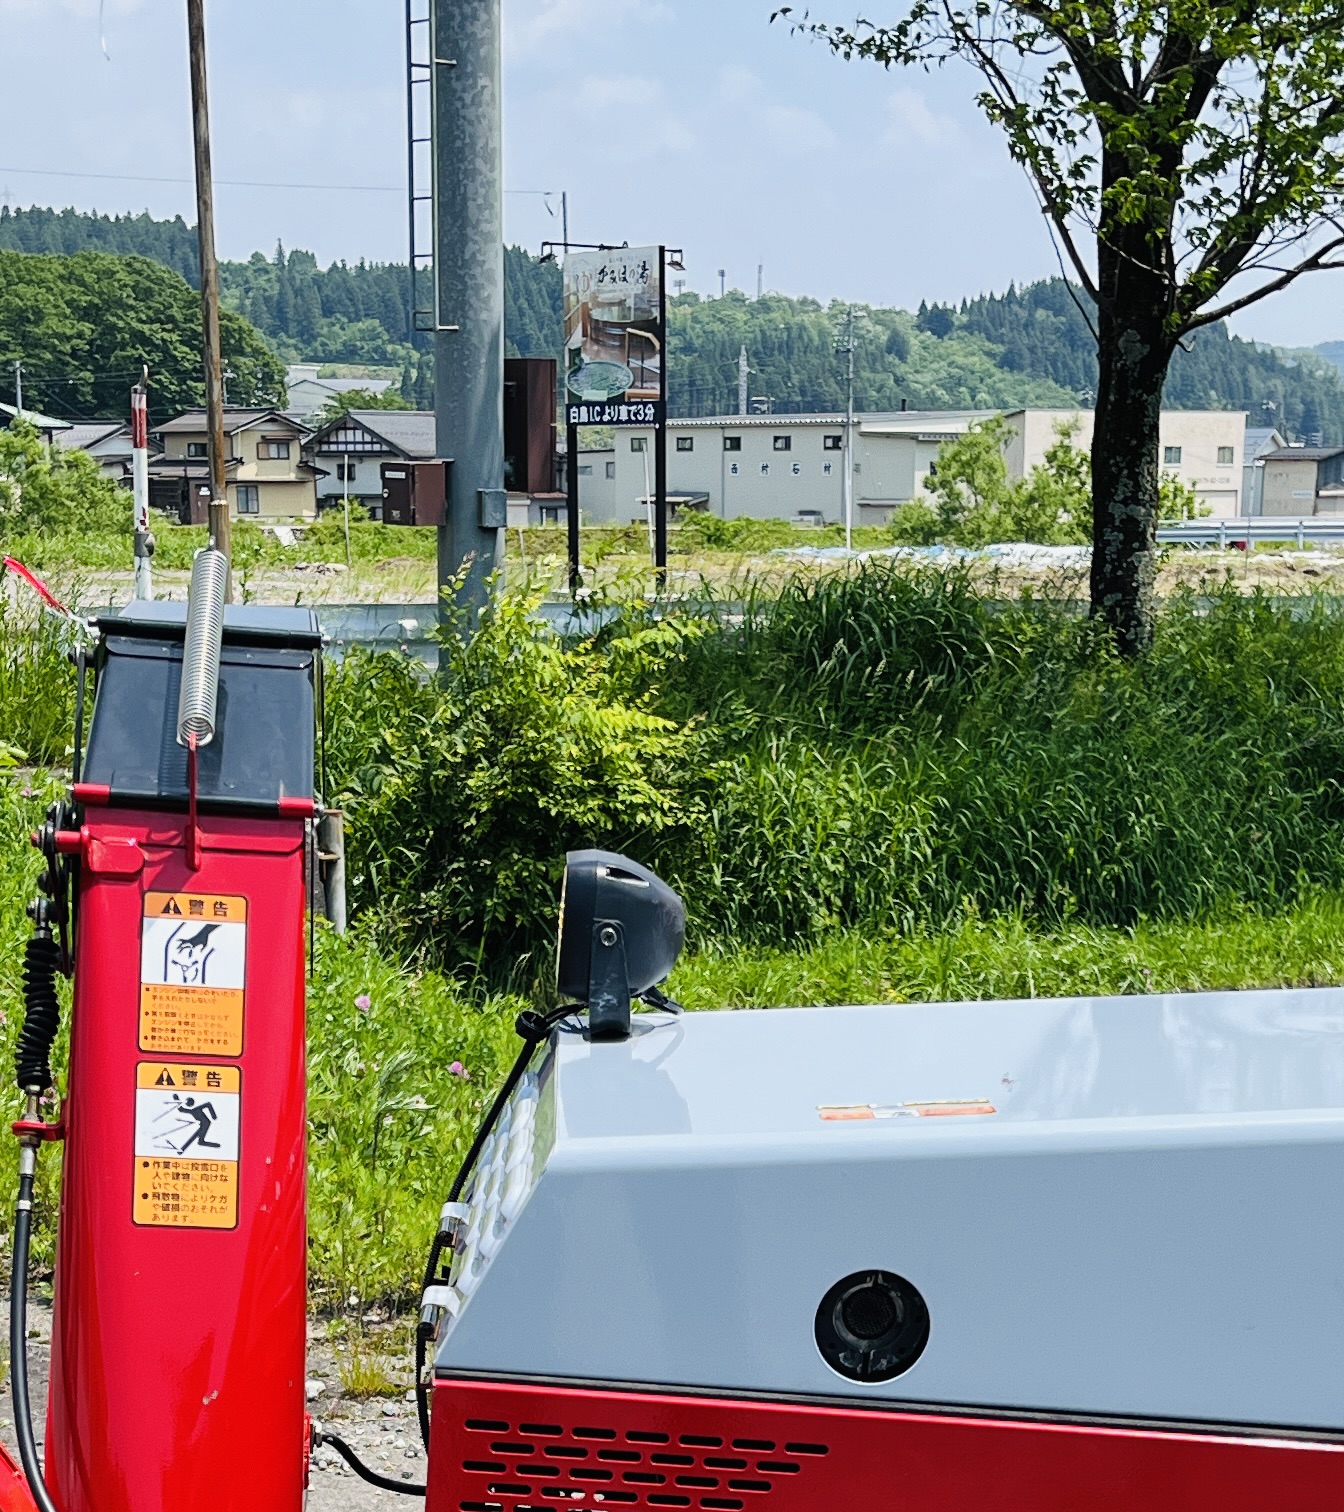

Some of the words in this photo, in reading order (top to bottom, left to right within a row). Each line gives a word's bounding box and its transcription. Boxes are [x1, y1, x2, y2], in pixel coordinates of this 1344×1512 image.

[189, 899, 229, 917] 警告
[181, 1069, 222, 1087] 警告
[152, 1171, 229, 1182] 人や建物に向けな
[152, 1182, 214, 1193] いでください。
[151, 1213, 194, 1223] あります。
